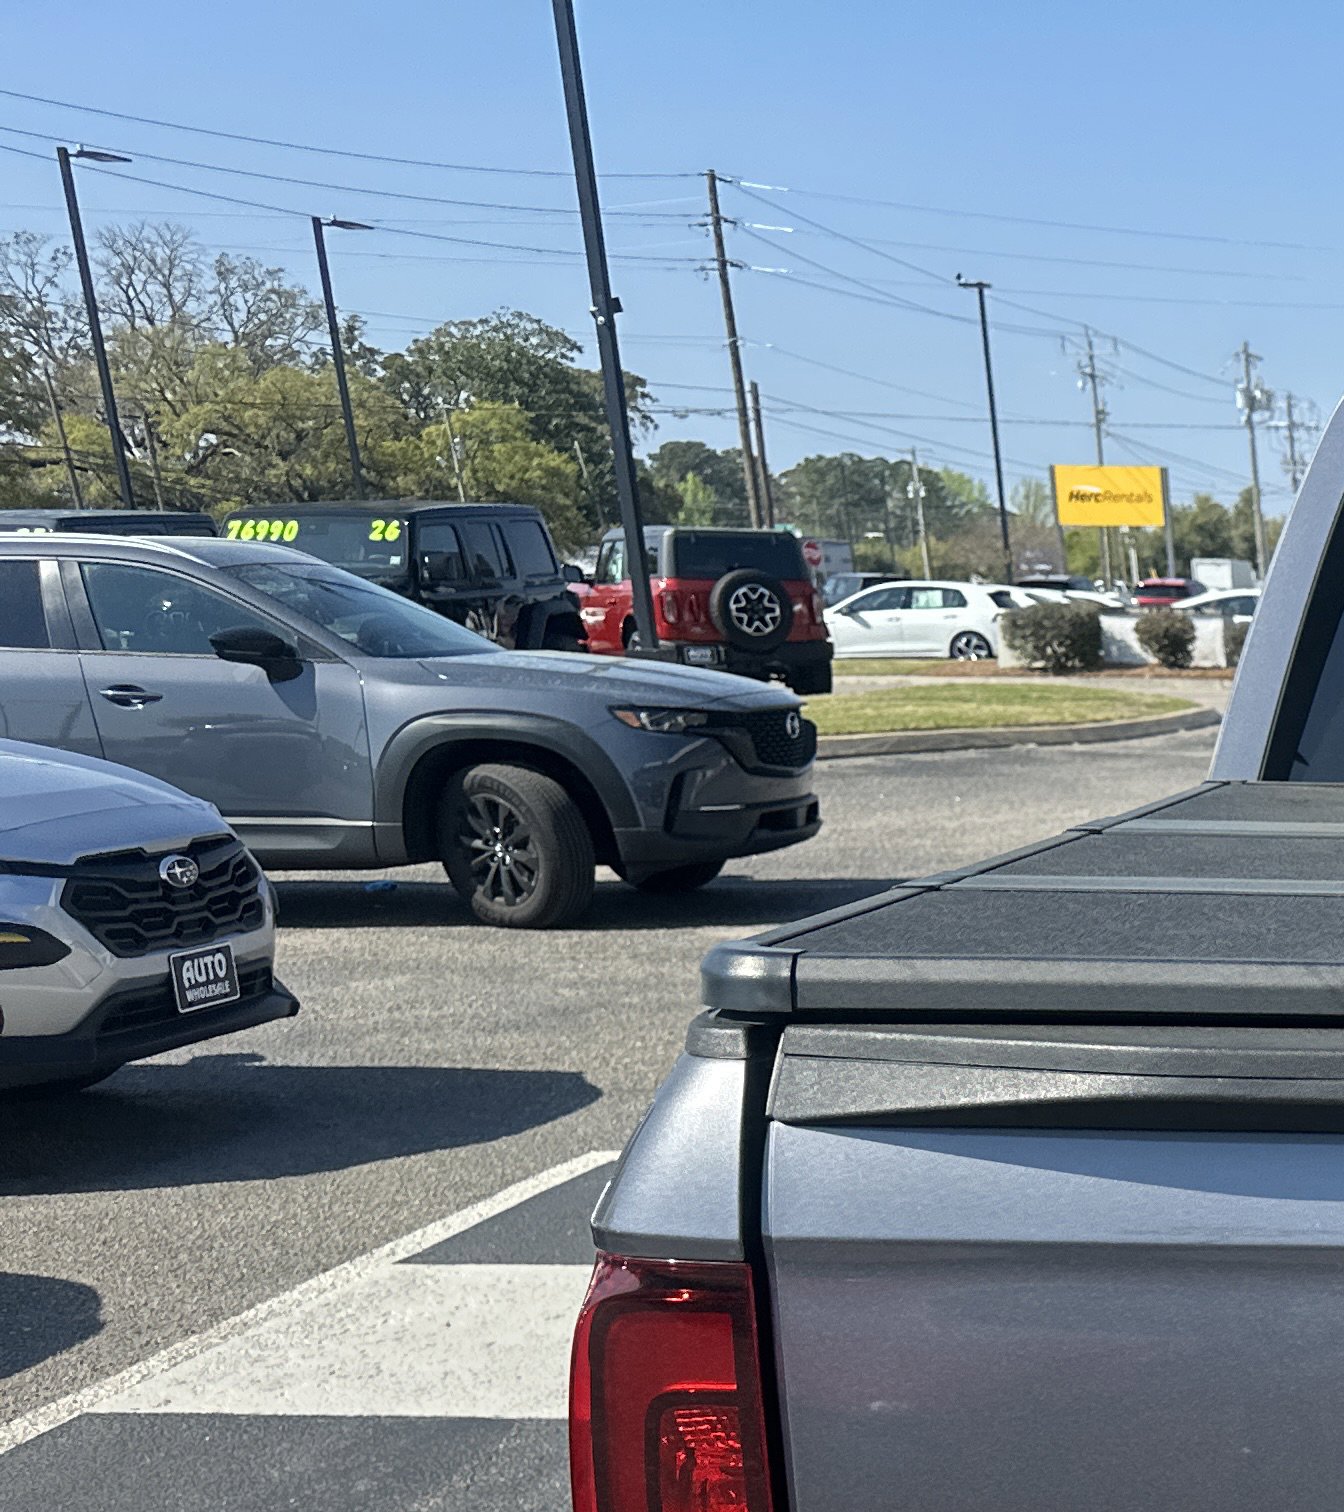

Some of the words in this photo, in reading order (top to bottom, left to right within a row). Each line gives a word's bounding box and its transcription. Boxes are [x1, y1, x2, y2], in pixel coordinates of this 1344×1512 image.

[226, 519, 299, 542] 76990
[368, 519, 401, 542] 26
[182, 952, 227, 989] AUTO
[185, 980, 231, 1002] WHOLESALE
